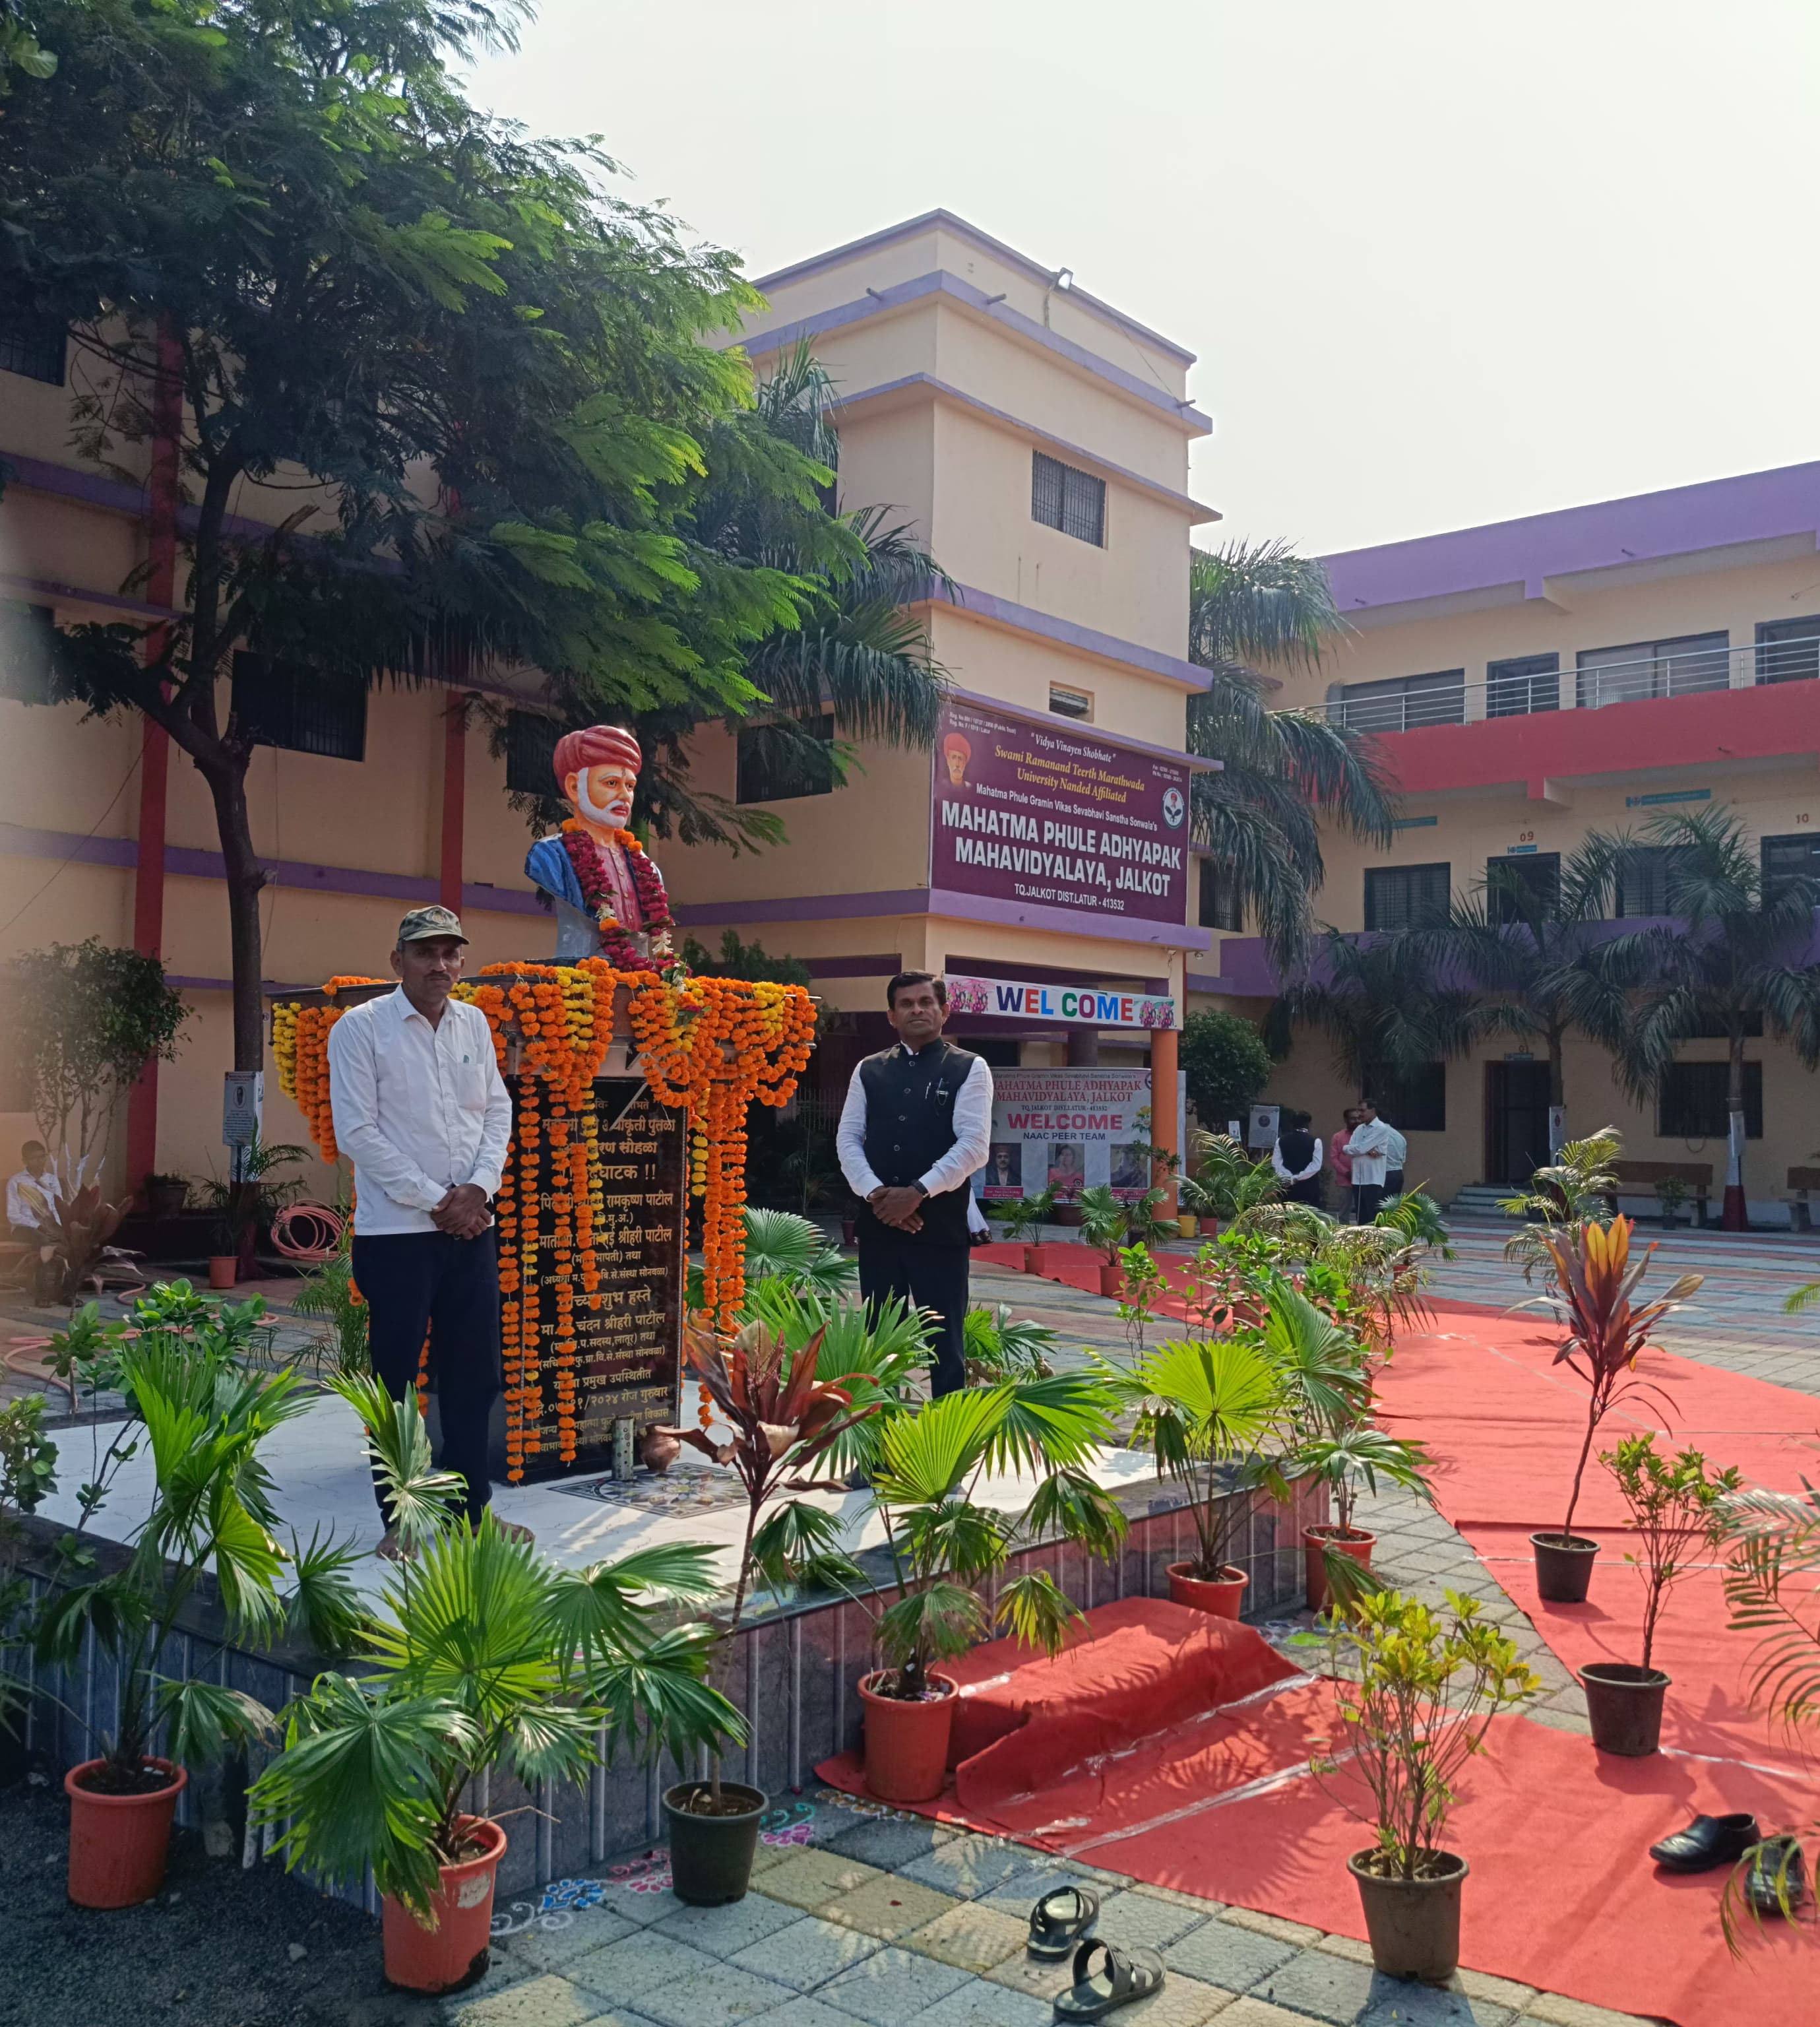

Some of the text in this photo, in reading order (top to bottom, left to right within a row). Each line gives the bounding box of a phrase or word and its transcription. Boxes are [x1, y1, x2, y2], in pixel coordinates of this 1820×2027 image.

[1055, 740, 1082, 756] Vinayen
[995, 746, 1024, 764] Swami
[1025, 753, 1070, 773] Ramanand
[1073, 763, 1096, 780] Teerth
[1098, 770, 1145, 791] Marathwada
[1017, 767, 1127, 803] University Nanded Affiliated
[976, 783, 1158, 832] Mahatma Phule Gramin Vikas Sevabhavi Sanstha Sonwala's
[1796, 813, 1809, 824] 10
[942, 800, 1181, 870] MAHATMA PHULE ADHYAPAK
[1520, 831, 1534, 842] 09
[956, 837, 1170, 897] MAHAVIDYALAYA, JALKOT
[1102, 899, 1124, 911] 413532
[1046, 1081, 1080, 1090] PHULE
[1084, 1081, 1141, 1090] ADHYAPAK
[997, 1092, 1133, 1104] MAHAVIDYALAYA, JALKOT
[1008, 1114, 1123, 1130] WELCOME
[645, 1189, 674, 1206] पाटील
[617, 1225, 643, 1246] श्रीहरी
[644, 1225, 673, 1242] पाटील
[625, 1251, 641, 1260] तथा
[602, 1291, 623, 1310] शुभ
[604, 1313, 632, 1330] श्रीहरी
[635, 1310, 666, 1326] पाटील
[640, 1331, 655, 1341] तथा
